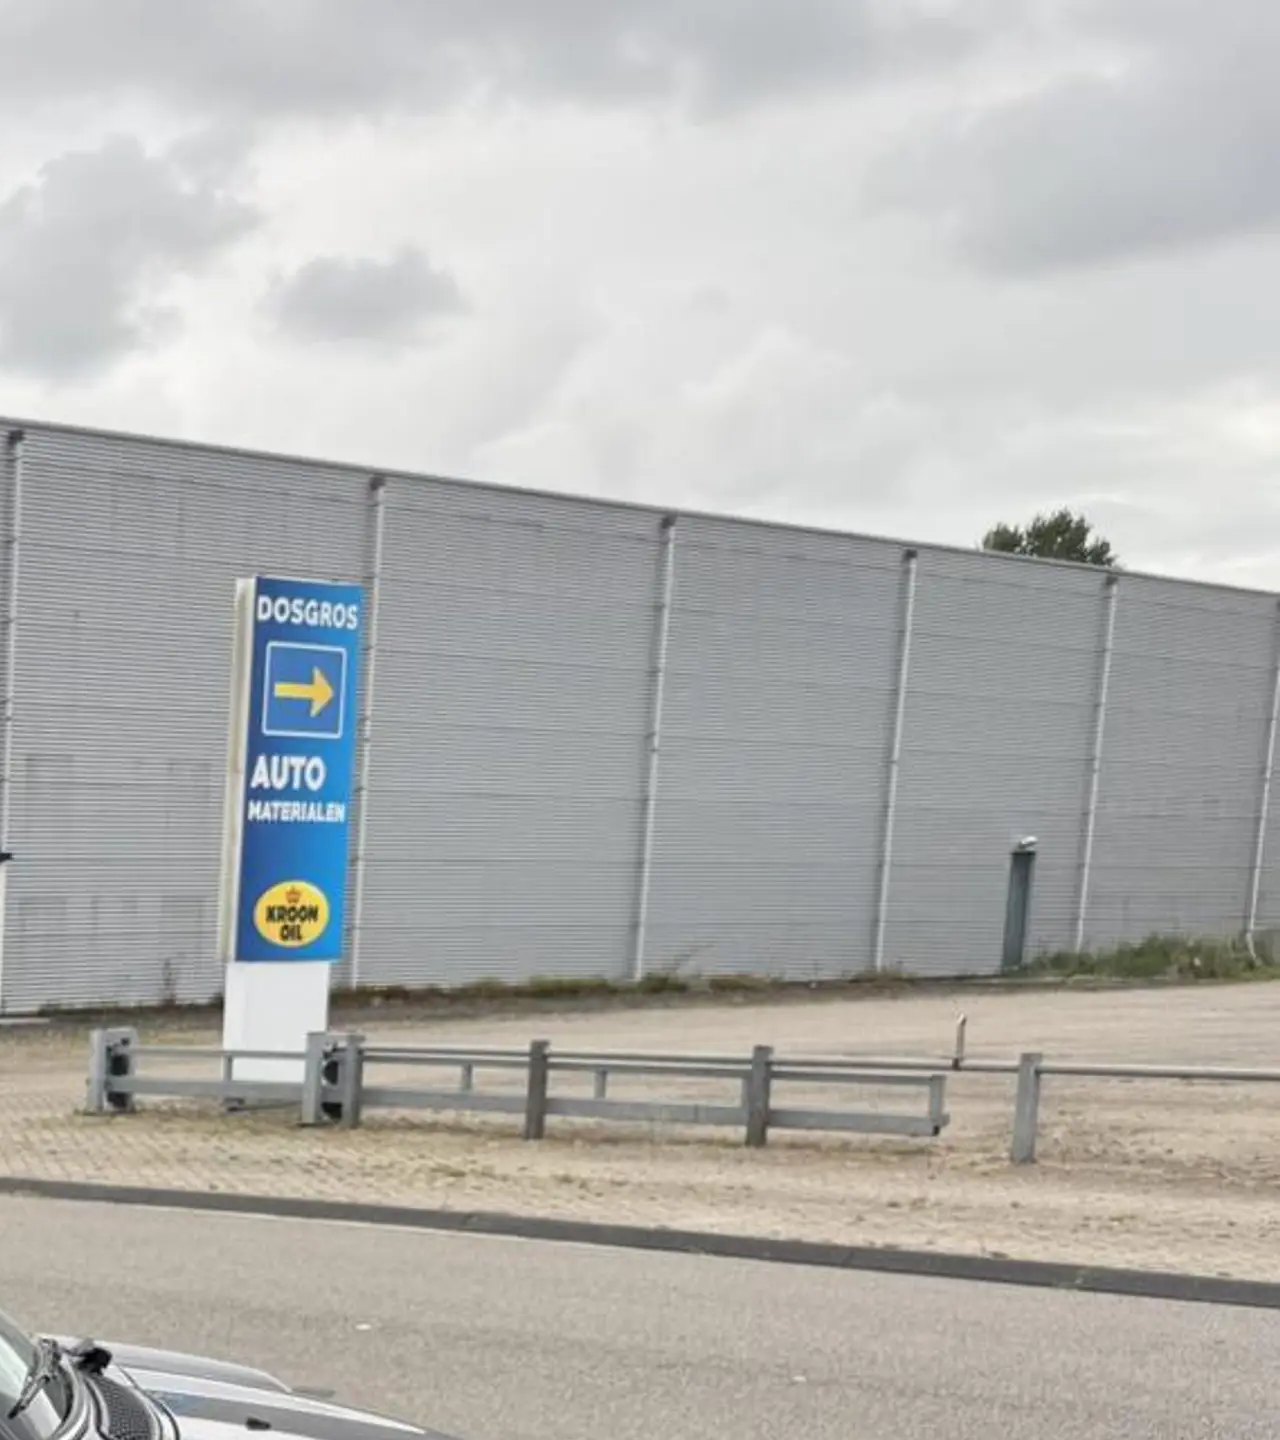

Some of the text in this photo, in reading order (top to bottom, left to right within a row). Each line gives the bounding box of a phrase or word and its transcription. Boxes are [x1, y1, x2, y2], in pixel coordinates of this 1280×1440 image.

[256, 595, 359, 630] DOSGROS
[250, 755, 326, 791] AUTO
[247, 798, 345, 823] MATERIALEN
[266, 904, 319, 923] KROON
[280, 924, 302, 941] OIL
